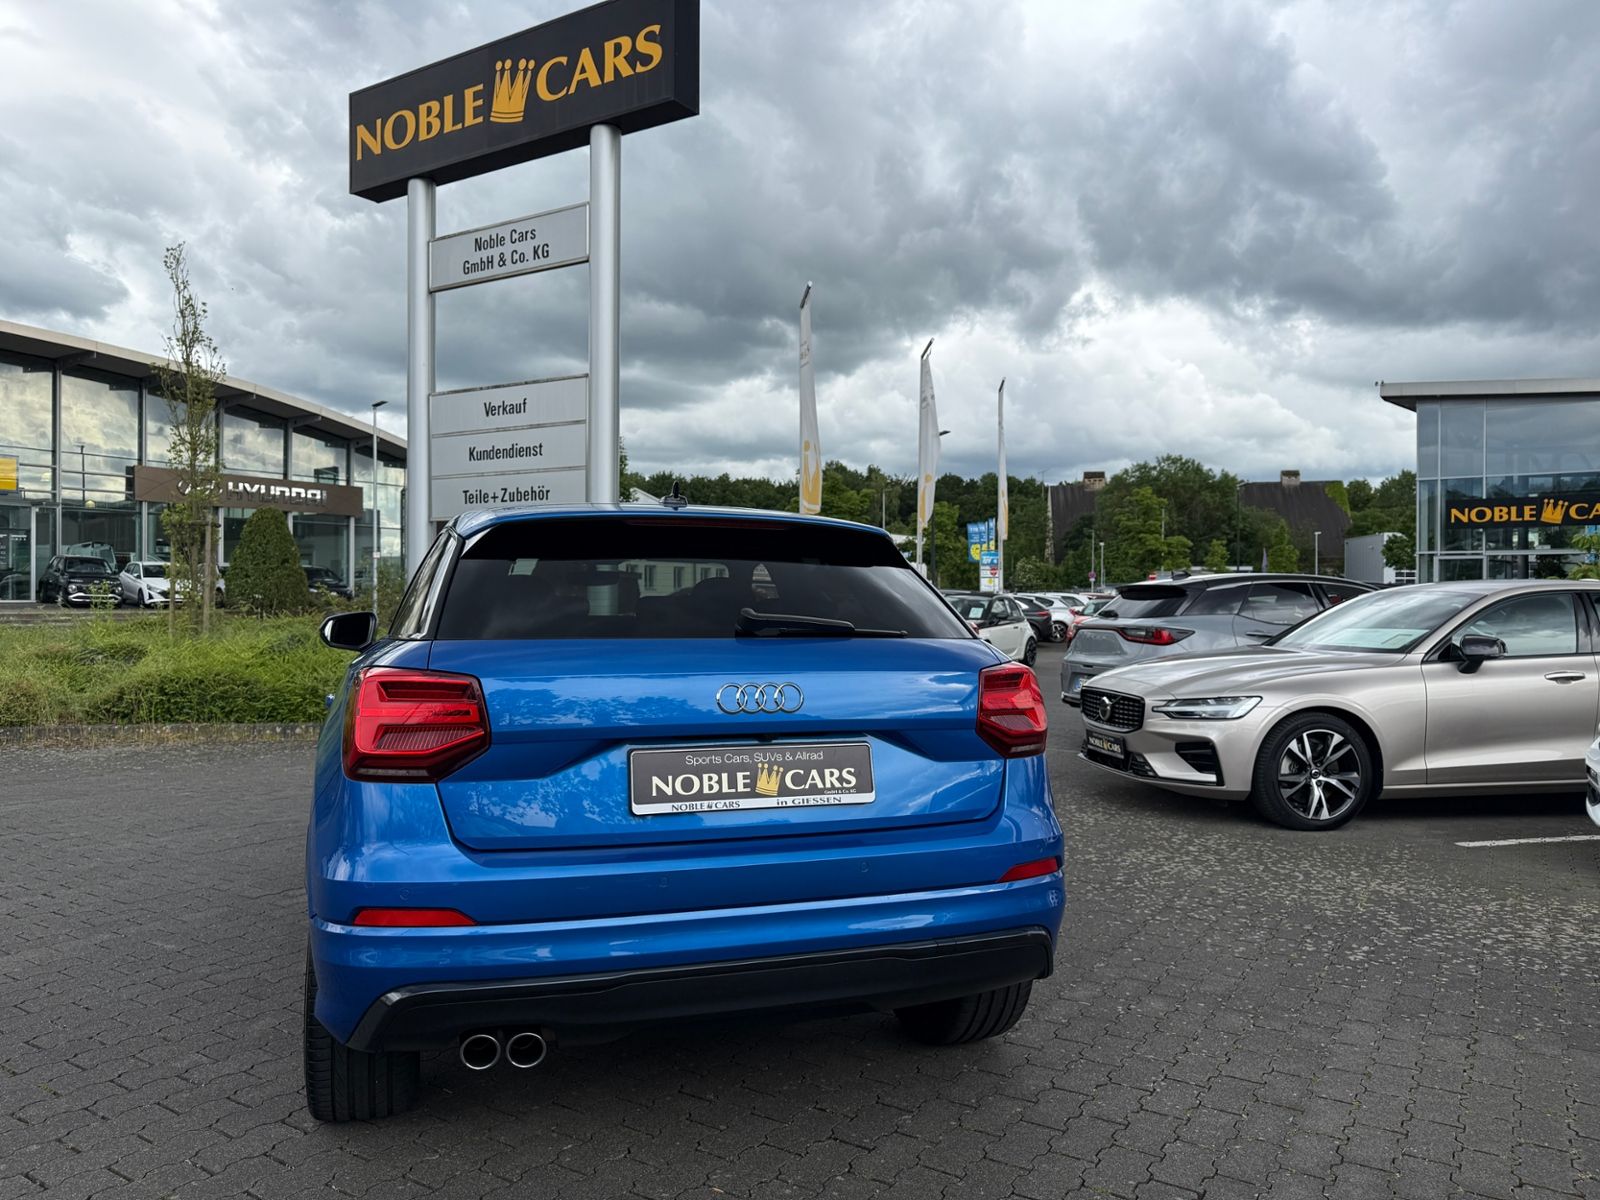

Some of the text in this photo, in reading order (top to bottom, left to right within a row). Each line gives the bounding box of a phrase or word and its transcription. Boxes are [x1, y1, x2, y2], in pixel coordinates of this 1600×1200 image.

[355, 24, 663, 160] NOBLE CARS
[474, 228, 537, 252] Noble Cars
[463, 243, 550, 275] GmbH & Co. KG
[484, 398, 527, 417] Verkauf
[468, 443, 543, 462] Kundendienst
[227, 481, 327, 502] HYUNDAI
[462, 486, 551, 505] Teile+Zubehör
[1450, 505, 1537, 524] NOBLE
[685, 750, 824, 766] Sports Cars, SUVs & Allrad
[651, 767, 857, 797] NOBLE CARS
[671, 800, 741, 812] NOBLE CARS
[776, 798, 788, 806] in
